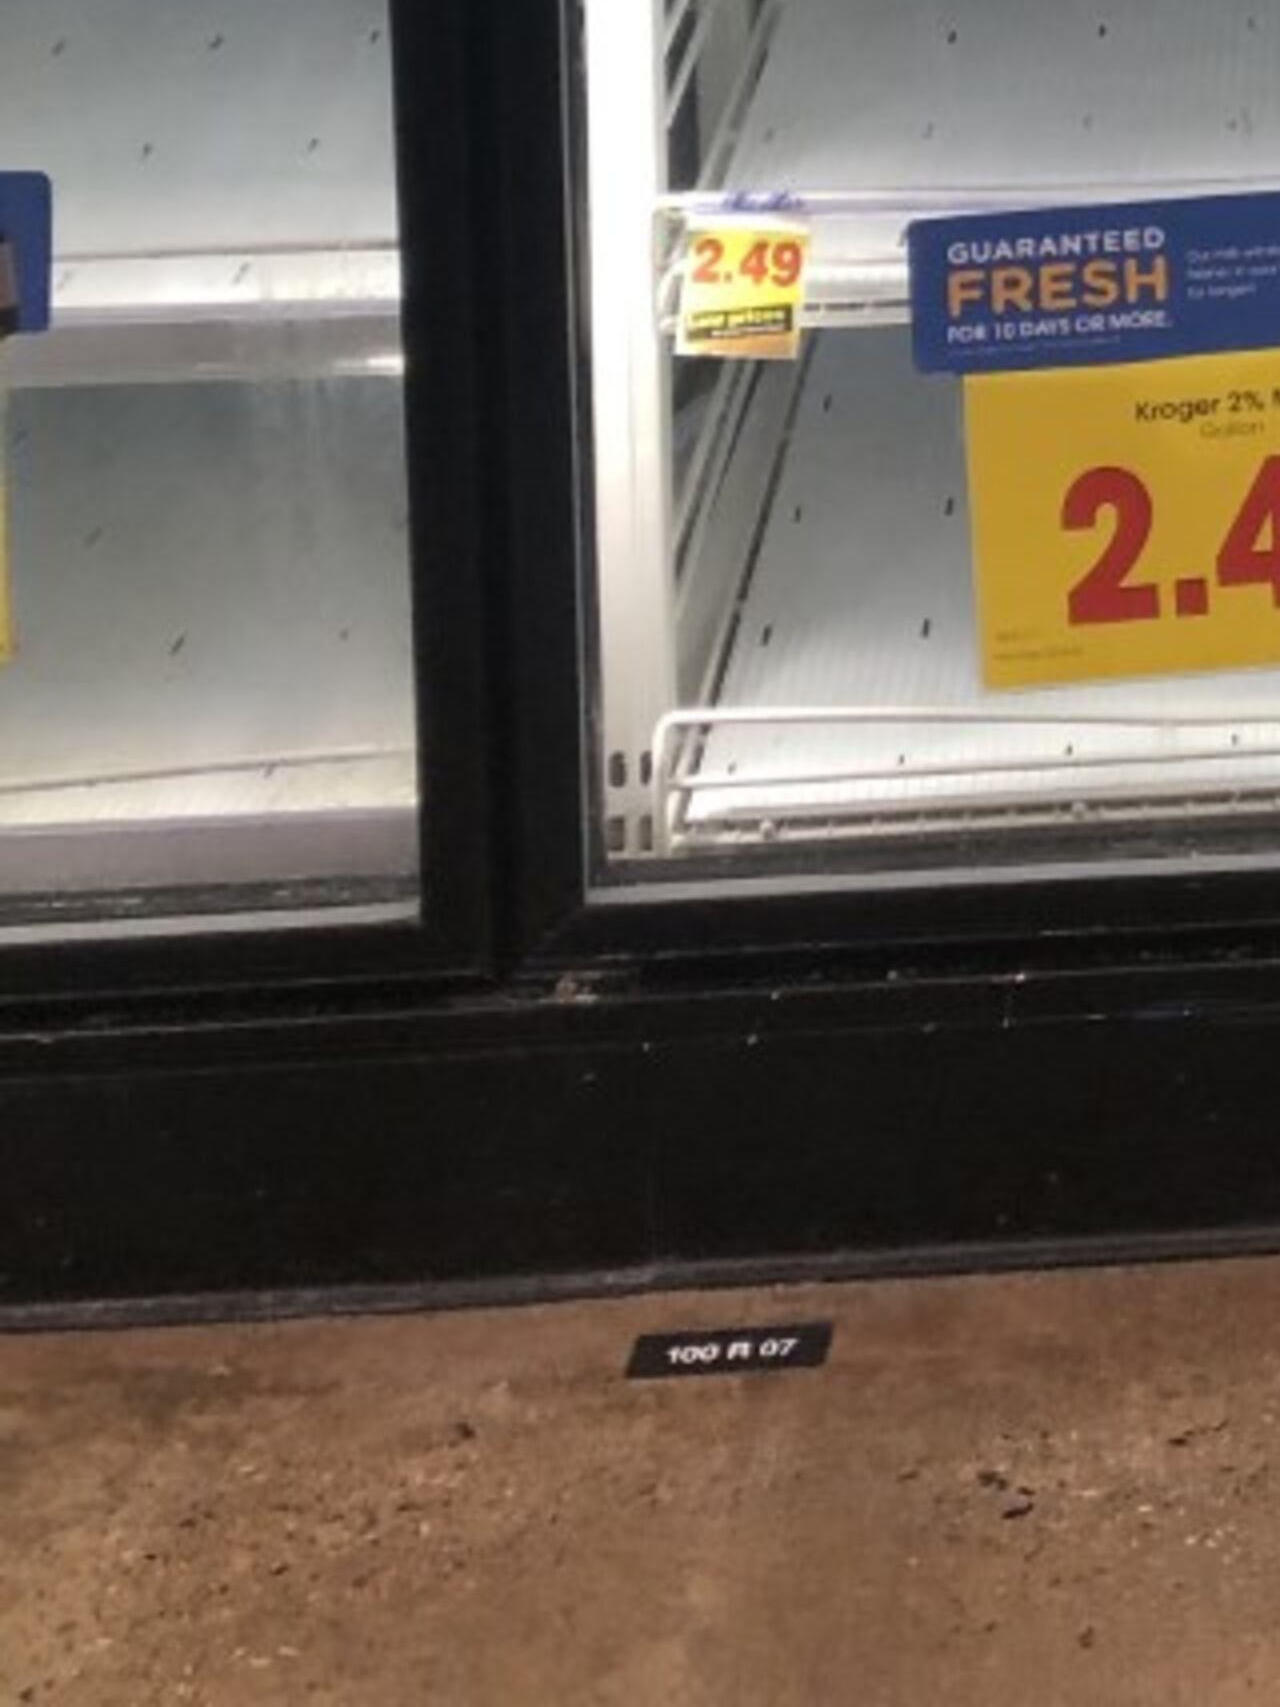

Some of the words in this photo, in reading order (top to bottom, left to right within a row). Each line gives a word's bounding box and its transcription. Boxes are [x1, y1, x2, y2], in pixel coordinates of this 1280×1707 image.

[692, 236, 803, 287] 2.49
[947, 227, 1166, 265] GUARANTEED
[947, 257, 1170, 319] FRESH
[946, 325, 986, 345] FOR
[995, 320, 1016, 342] 10
[1019, 318, 1069, 339] DAYS
[1075, 315, 1105, 334] OR
[1134, 396, 1221, 425] Kroger
[1227, 390, 1265, 414] 2%
[666, 1342, 720, 1364] 100
[759, 1338, 799, 1357] 07
